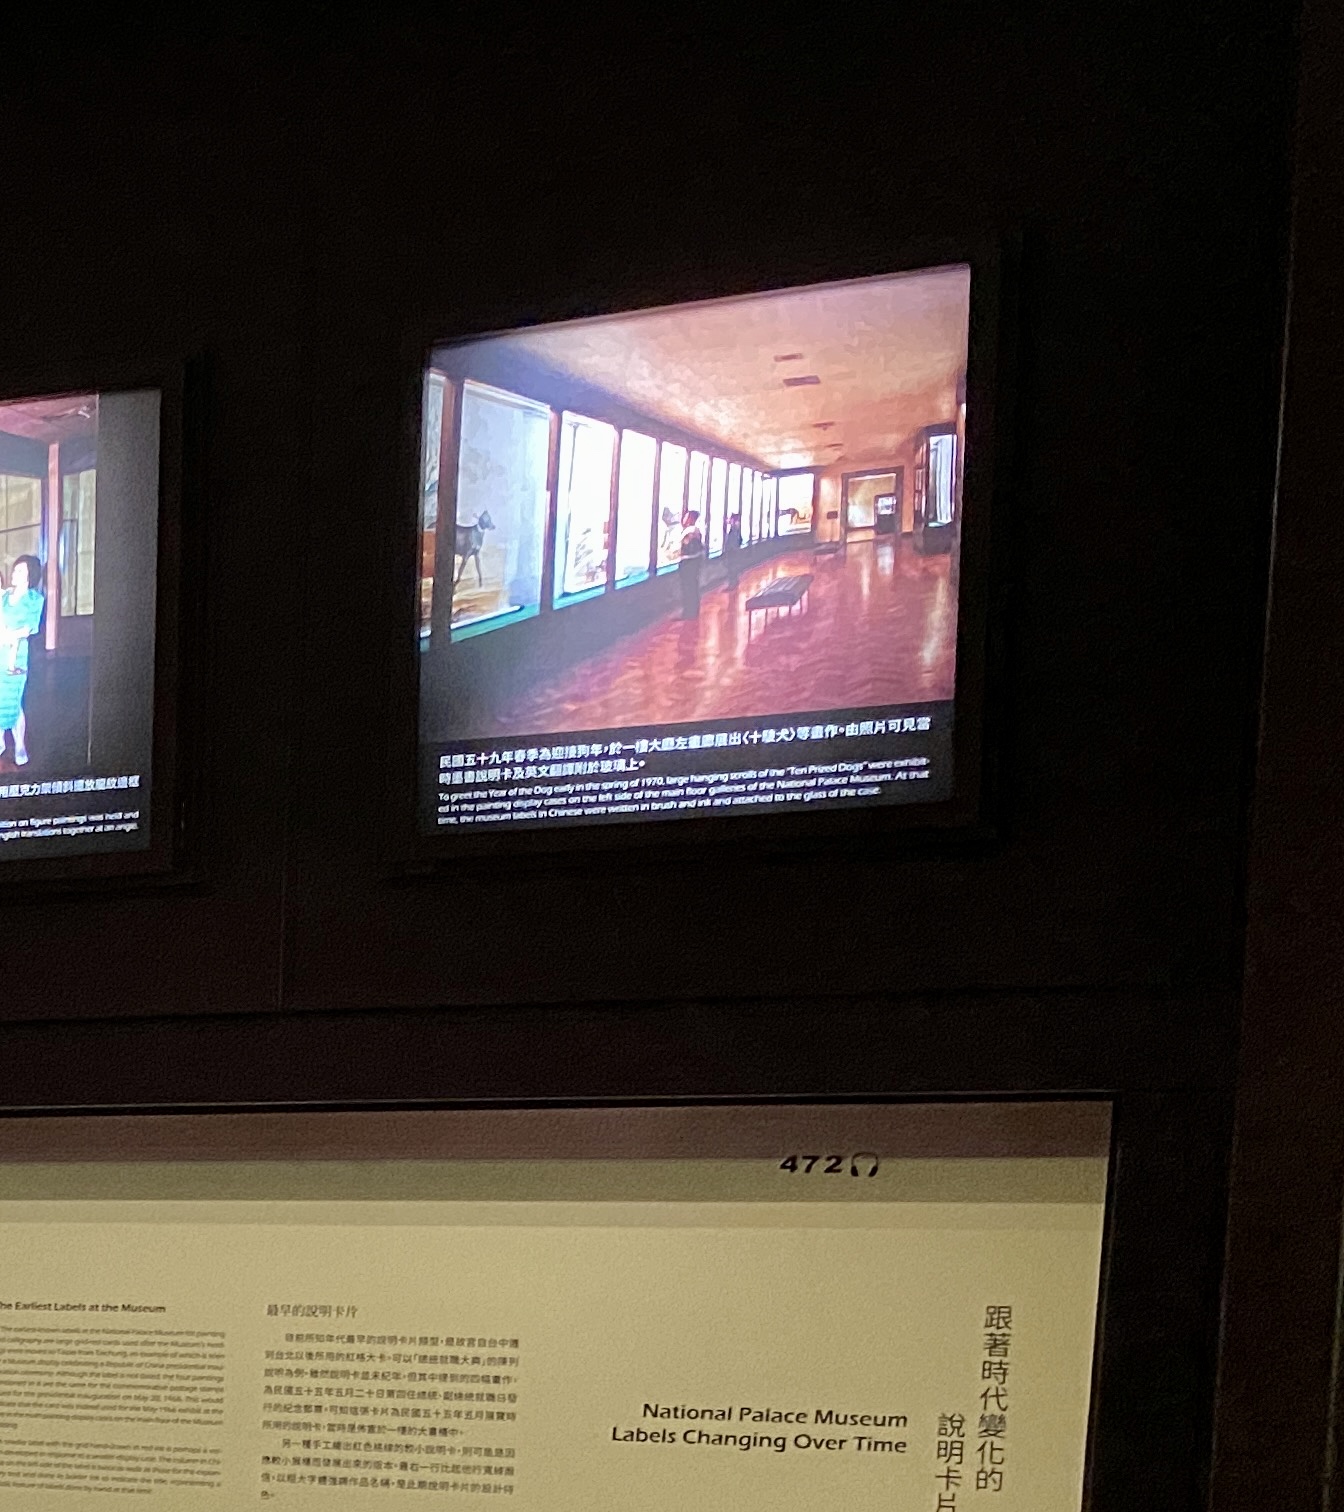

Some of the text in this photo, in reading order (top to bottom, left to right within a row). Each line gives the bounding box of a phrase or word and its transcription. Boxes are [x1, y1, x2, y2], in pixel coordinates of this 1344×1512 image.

[508, 788, 518, 797] of
[533, 785, 553, 797] Dog
[575, 783, 584, 792] in
[602, 780, 628, 792] spring
[629, 779, 640, 788] of
[666, 775, 689, 787] large
[690, 772, 729, 785] hanging
[758, 769, 769, 778] of
[769, 768, 785, 777] the
[568, 796, 581, 804] on
[633, 791, 643, 800] of
[644, 790, 661, 799] the
[662, 788, 684, 798] main
[747, 782, 758, 792] of
[759, 781, 775, 791] the
[776, 778, 816, 790] National
[817, 776, 848, 787] Palace
[538, 810, 547, 818] in
[640, 803, 649, 812] in
[678, 800, 696, 809] and
[697, 799, 711, 807] ink
[713, 797, 731, 806] and
[774, 793, 785, 802] to
[786, 792, 802, 801] the
[803, 790, 826, 802] glass
[828, 789, 839, 798] of
[839, 788, 856, 797] the
[780, 1155, 843, 1174] 472
[14, 1302, 52, 1311] Earliest
[54, 1302, 86, 1312] Labels
[88, 1303, 99, 1312] at
[101, 1303, 118, 1312] the
[121, 1304, 166, 1313] Museum
[976, 1306, 1012, 1492] 跟著時代變化的
[642, 1403, 908, 1428] National Palace Museum
[612, 1427, 907, 1454] Labels Changing Over Time
